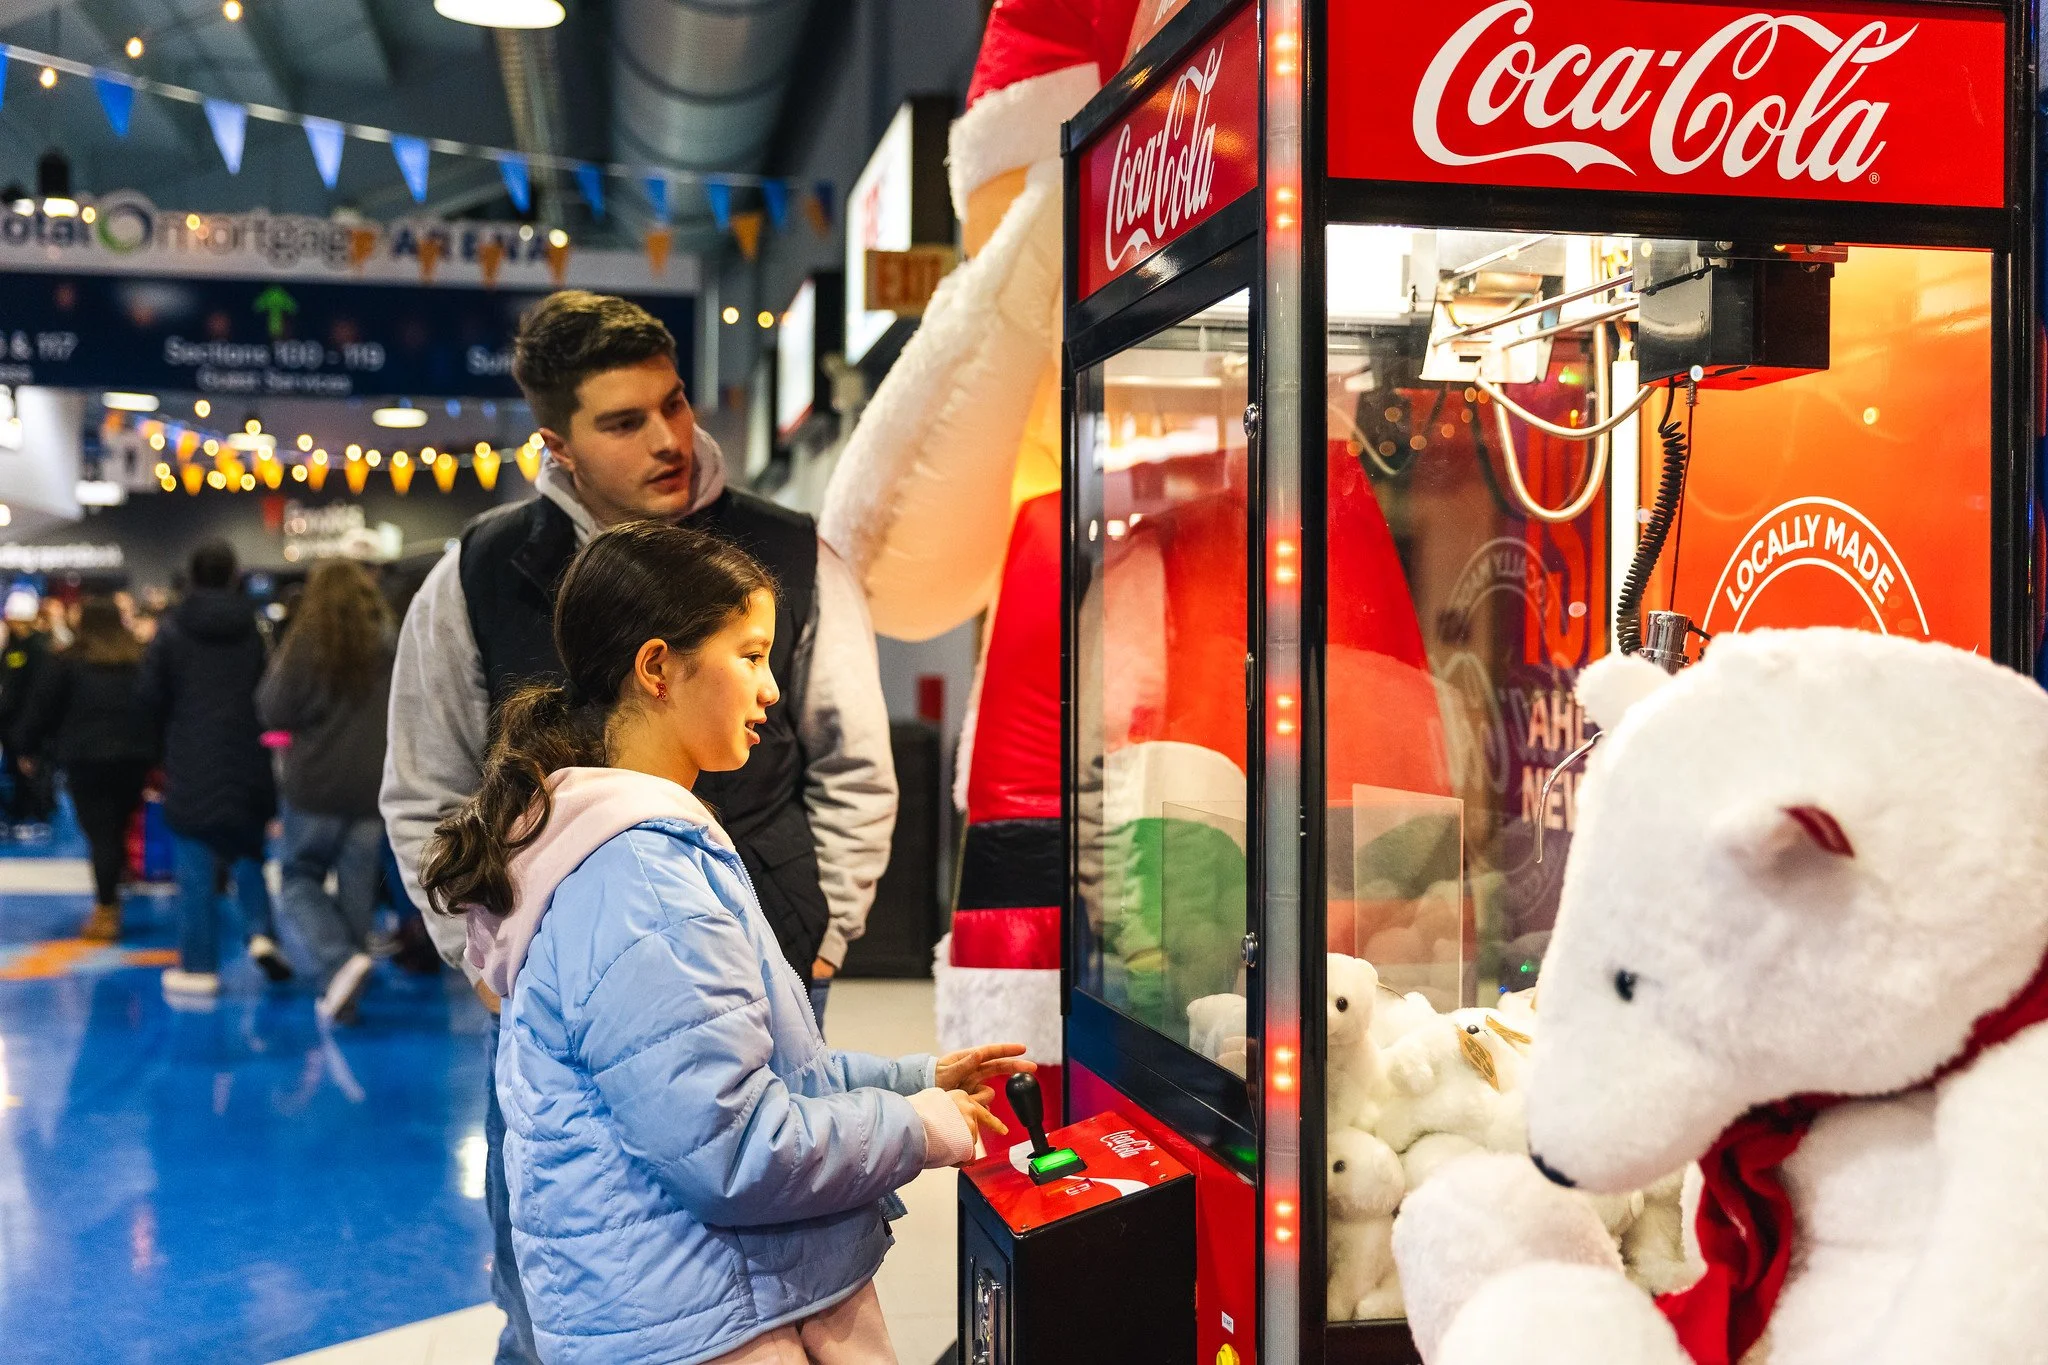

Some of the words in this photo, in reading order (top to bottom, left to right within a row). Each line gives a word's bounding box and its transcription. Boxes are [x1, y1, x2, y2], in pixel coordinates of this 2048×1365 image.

[1105, 38, 1225, 272] Coca-Cola
[1414, 0, 1919, 183] Coca-Cola
[1726, 514, 1821, 612] LOCALLY
[1824, 517, 1895, 605] MADE
